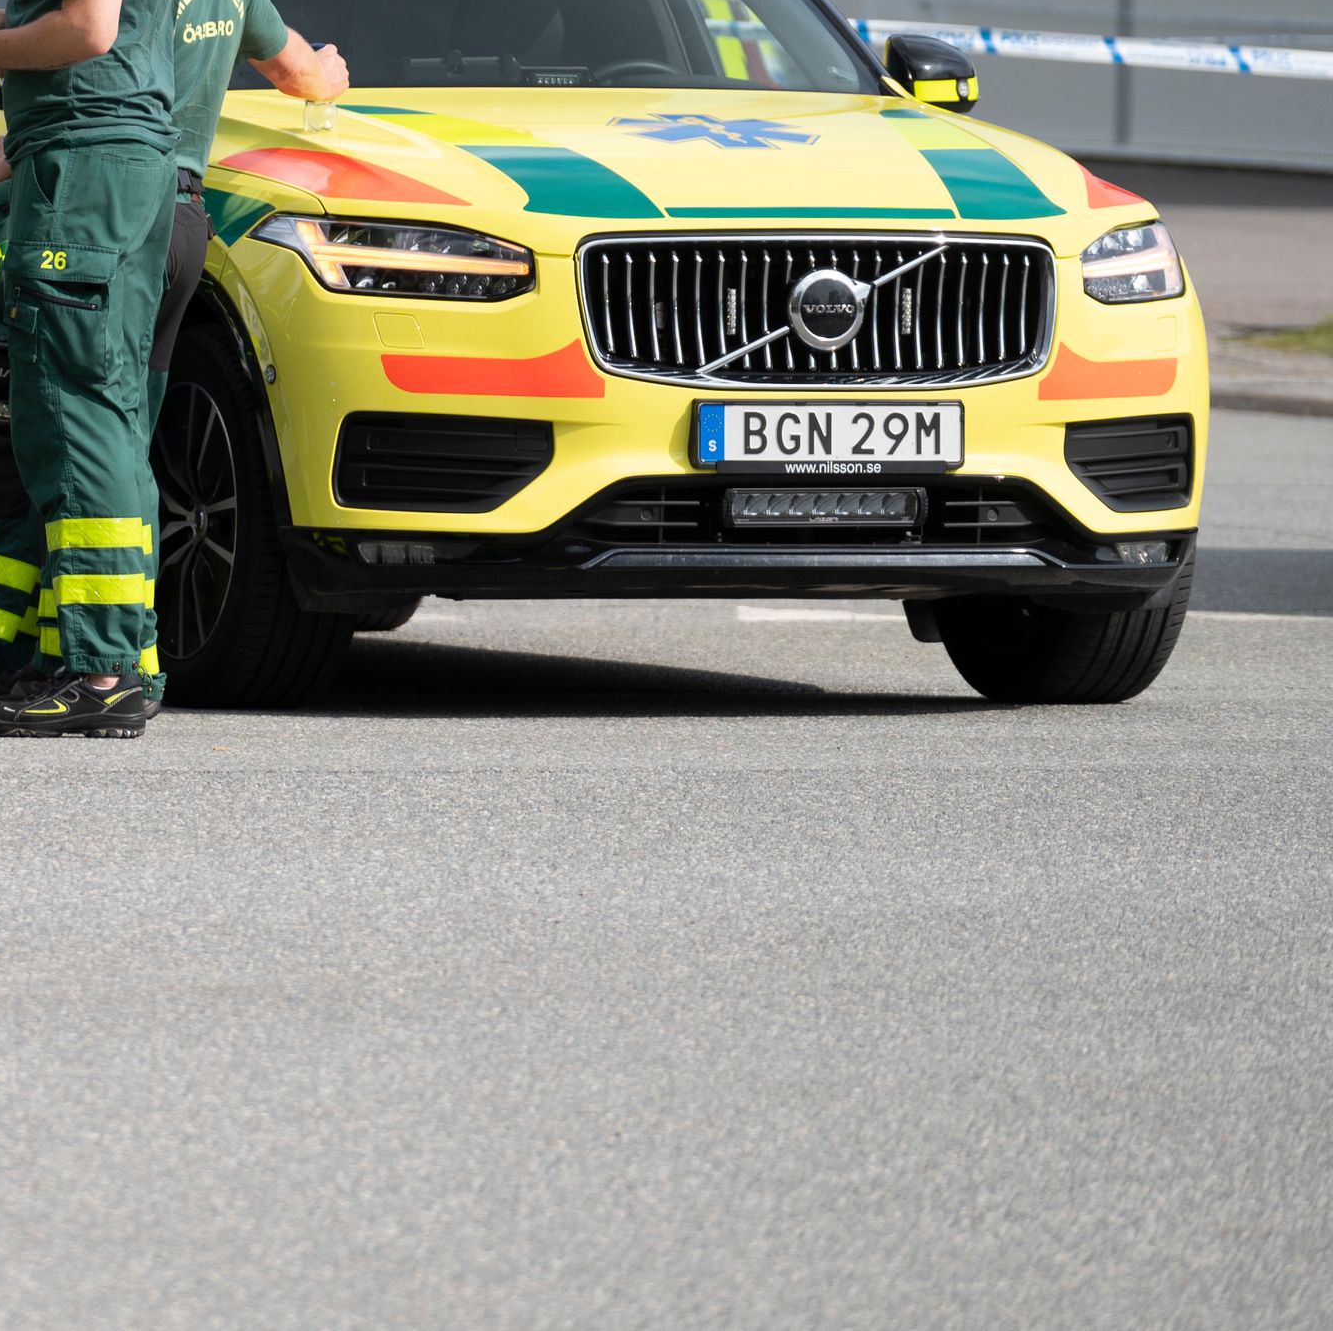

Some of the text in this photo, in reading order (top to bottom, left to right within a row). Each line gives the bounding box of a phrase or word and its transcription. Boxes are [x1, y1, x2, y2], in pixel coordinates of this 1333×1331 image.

[40, 250, 68, 270] 26
[802, 303, 856, 314] VOLVO
[743, 411, 941, 455] BGN 29M
[707, 439, 718, 453] S
[784, 461, 883, 474] www.nilsson.se
